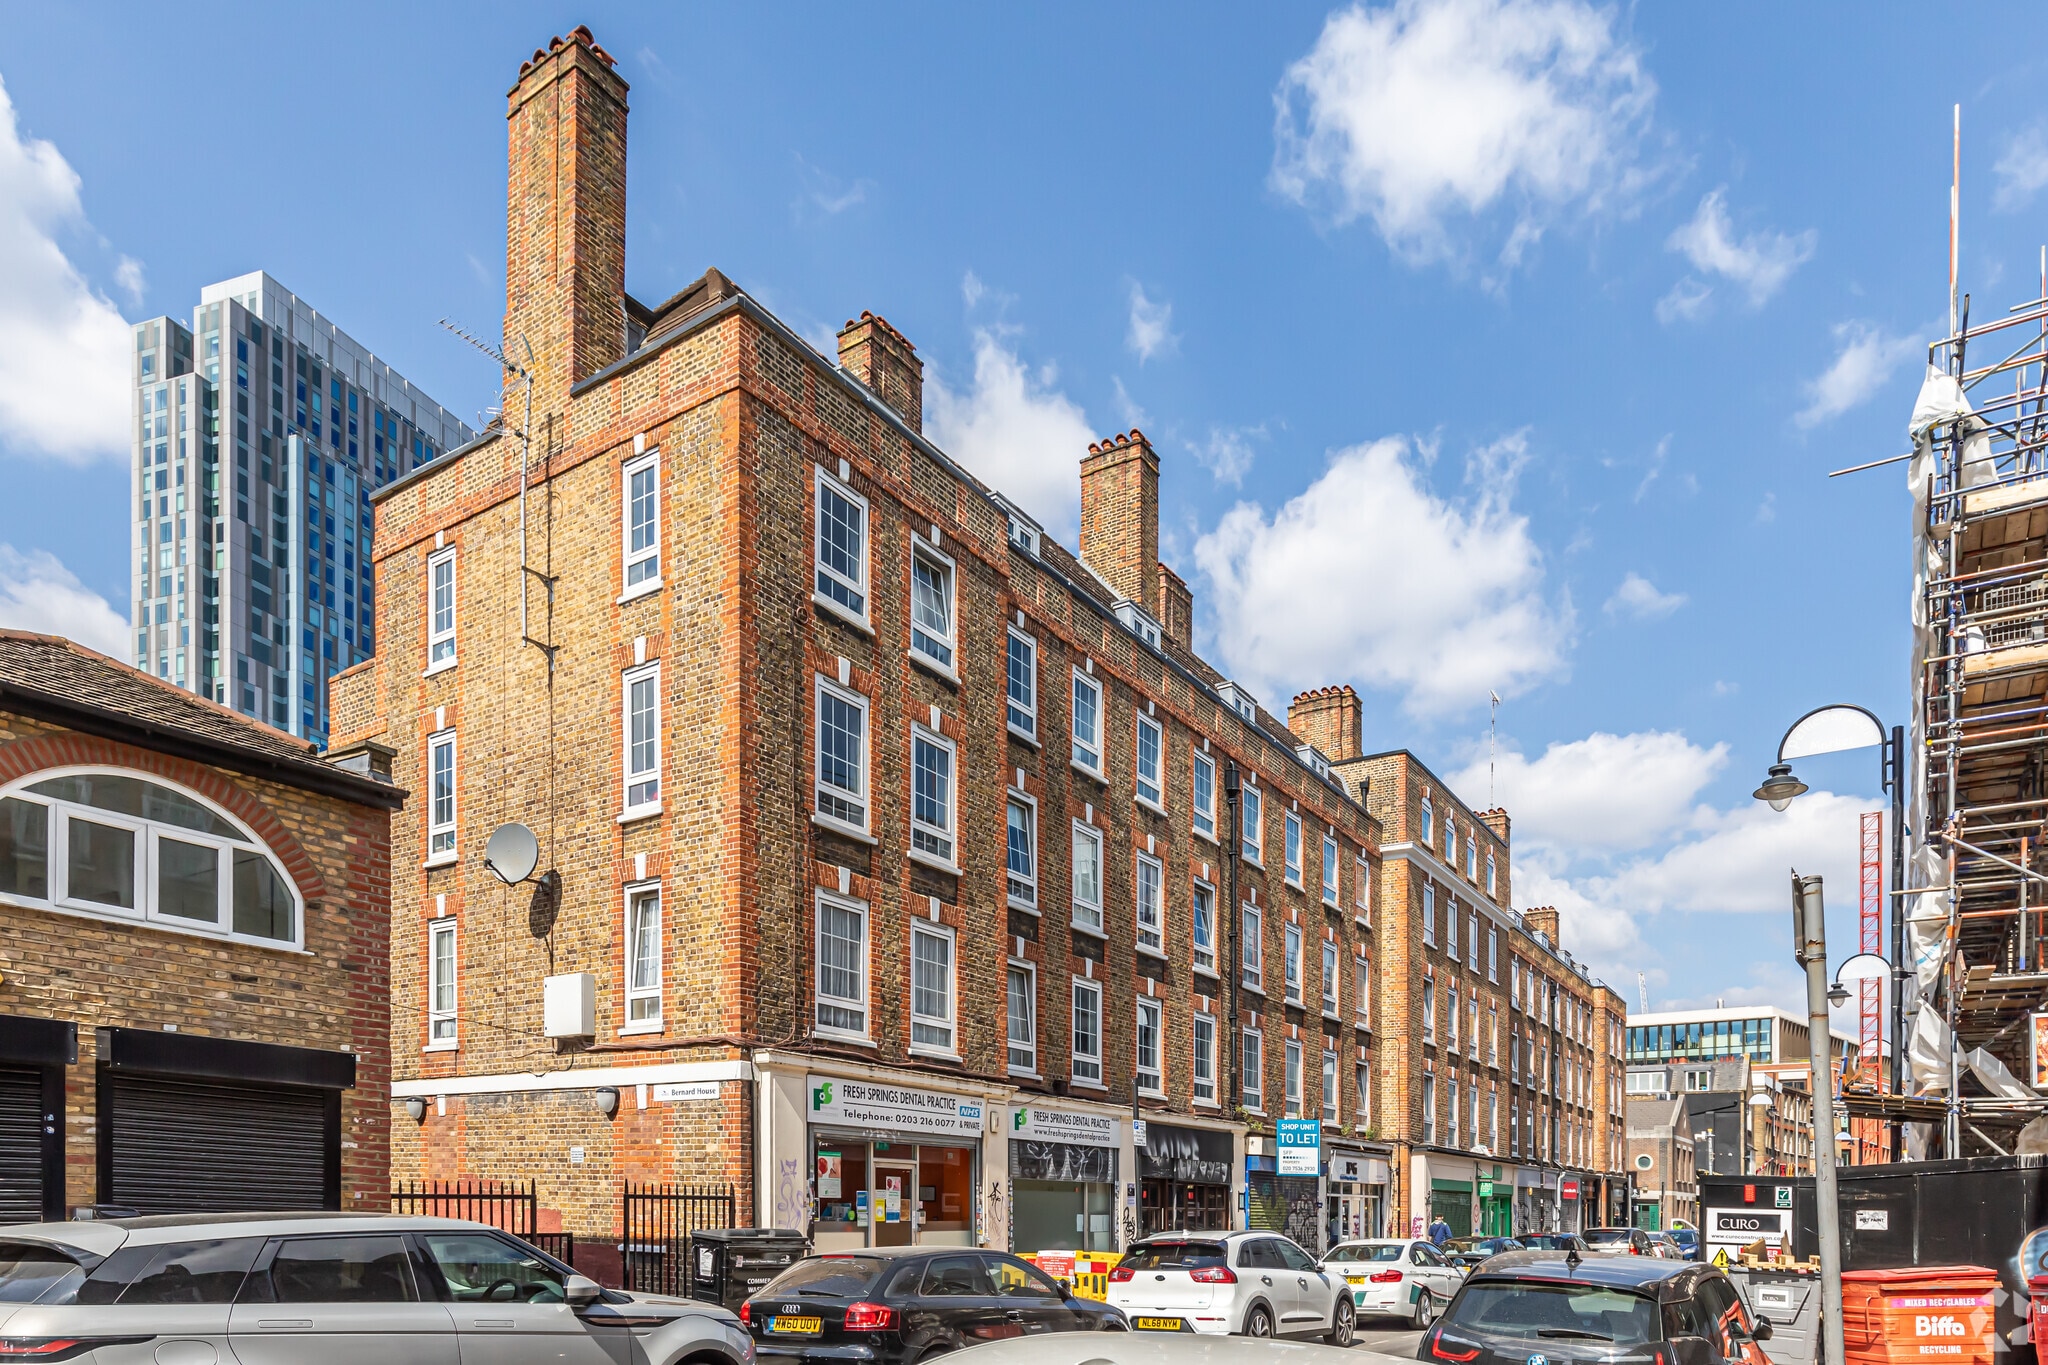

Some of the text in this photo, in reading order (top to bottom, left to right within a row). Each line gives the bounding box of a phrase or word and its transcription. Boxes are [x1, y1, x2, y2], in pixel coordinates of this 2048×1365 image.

[671, 1087, 716, 1096] Bernard House
[843, 1085, 956, 1110] FRESH SPRINGS DENTAL PRACTICE
[960, 1107, 980, 1117] NHS
[843, 1109, 893, 1122] Telephone:
[895, 1114, 918, 1124] 0203
[920, 1116, 933, 1126] 216
[935, 1118, 956, 1128] 0077
[1033, 1111, 1110, 1129] FRESH SPRINGS DENTAL PRACTICE
[964, 1121, 980, 1130] PRIVATE
[1034, 1128, 1110, 1142] www.freshspringsdentalpractice
[1280, 1133, 1317, 1144] TO LET
[1719, 1218, 1760, 1230] CURO
[1904, 1298, 1976, 1307] MIXED RECYCLABLES
[800, 1317, 819, 1330] UOV
[1142, 1318, 1178, 1328] NL68 NYM
[1915, 1315, 1965, 1336] Biffa
[1919, 1345, 1962, 1354] RECYCLING
